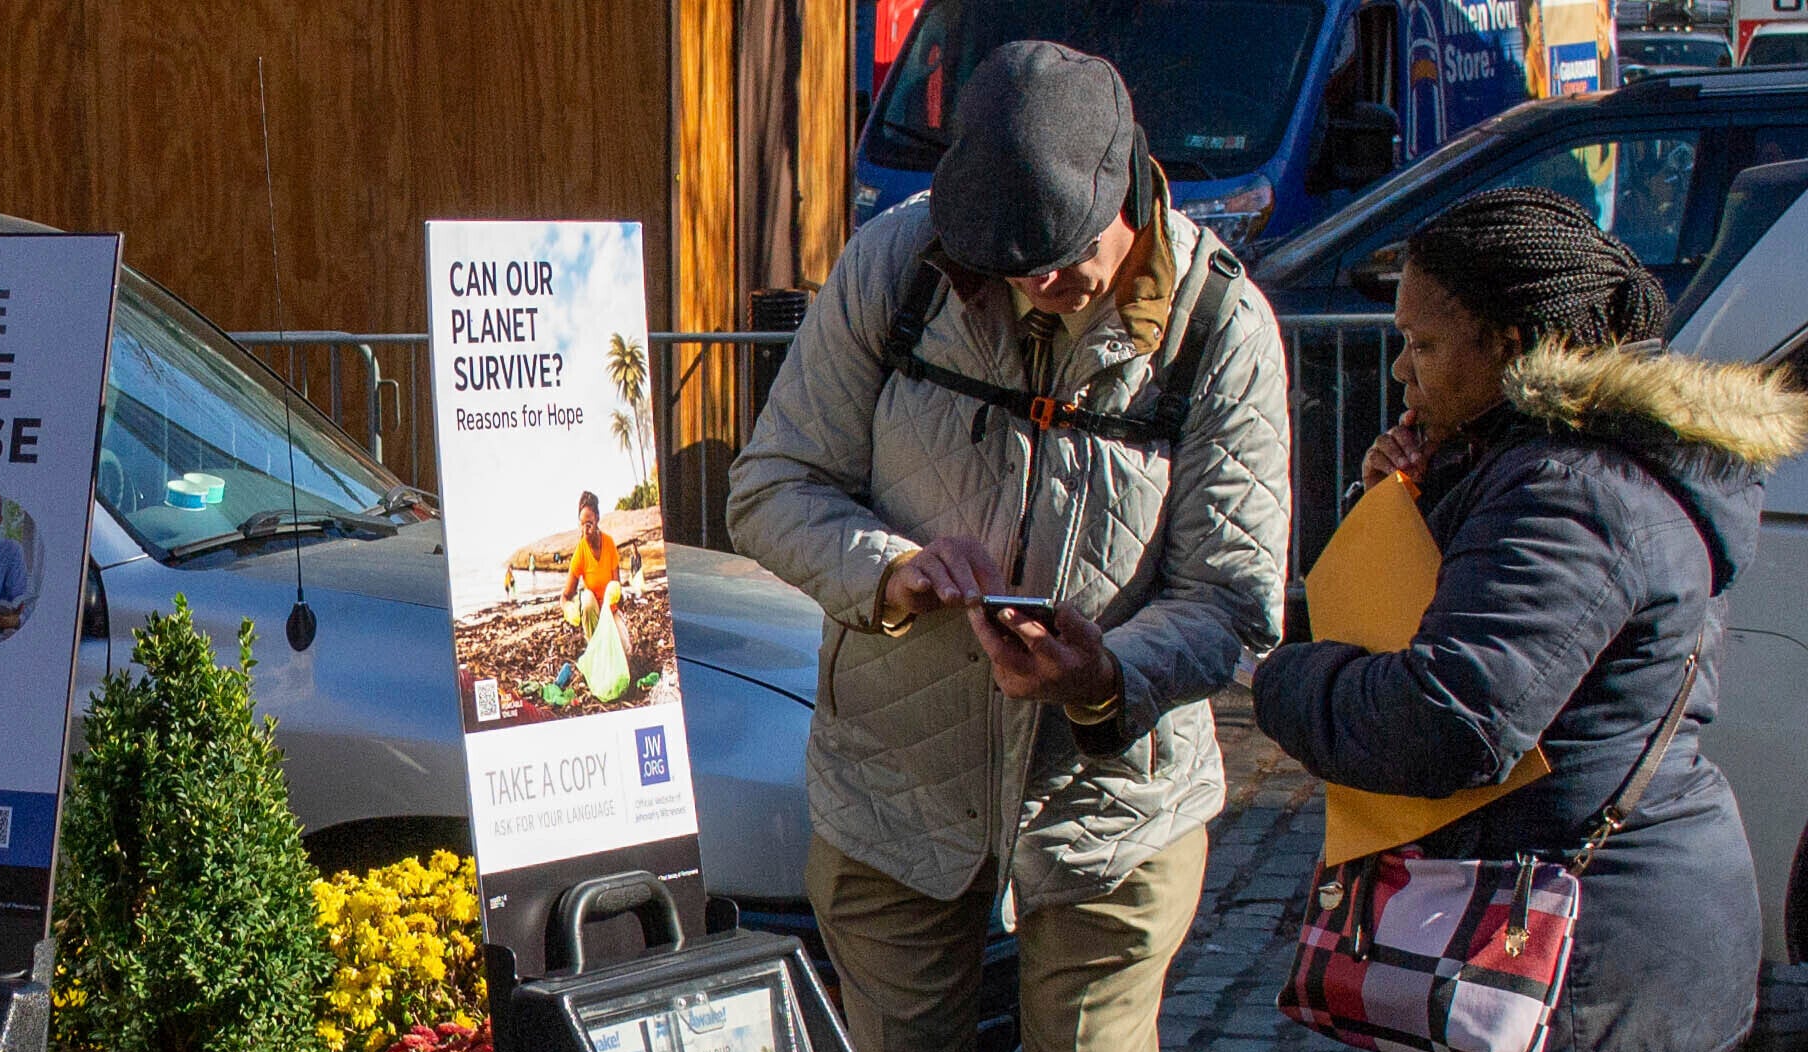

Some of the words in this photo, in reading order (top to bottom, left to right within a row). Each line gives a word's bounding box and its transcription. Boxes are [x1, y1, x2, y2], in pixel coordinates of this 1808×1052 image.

[1442, 0, 1489, 35] When
[1487, 0, 1518, 31] You
[449, 261, 497, 297] CAN
[506, 261, 554, 296] OUR
[451, 307, 538, 344] PLANET
[453, 353, 563, 392] SURVIVE?
[456, 407, 518, 432] Reasons
[522, 404, 543, 428] for
[547, 403, 584, 432] Hope
[642, 733, 662, 759] JW
[485, 764, 536, 806] TAKE
[542, 761, 556, 798] A
[559, 751, 608, 793] COPY
[493, 818, 513, 837] ASK
[516, 813, 535, 833] FOR
[537, 808, 563, 829] YOUR
[566, 799, 616, 824] LANGUAGE
